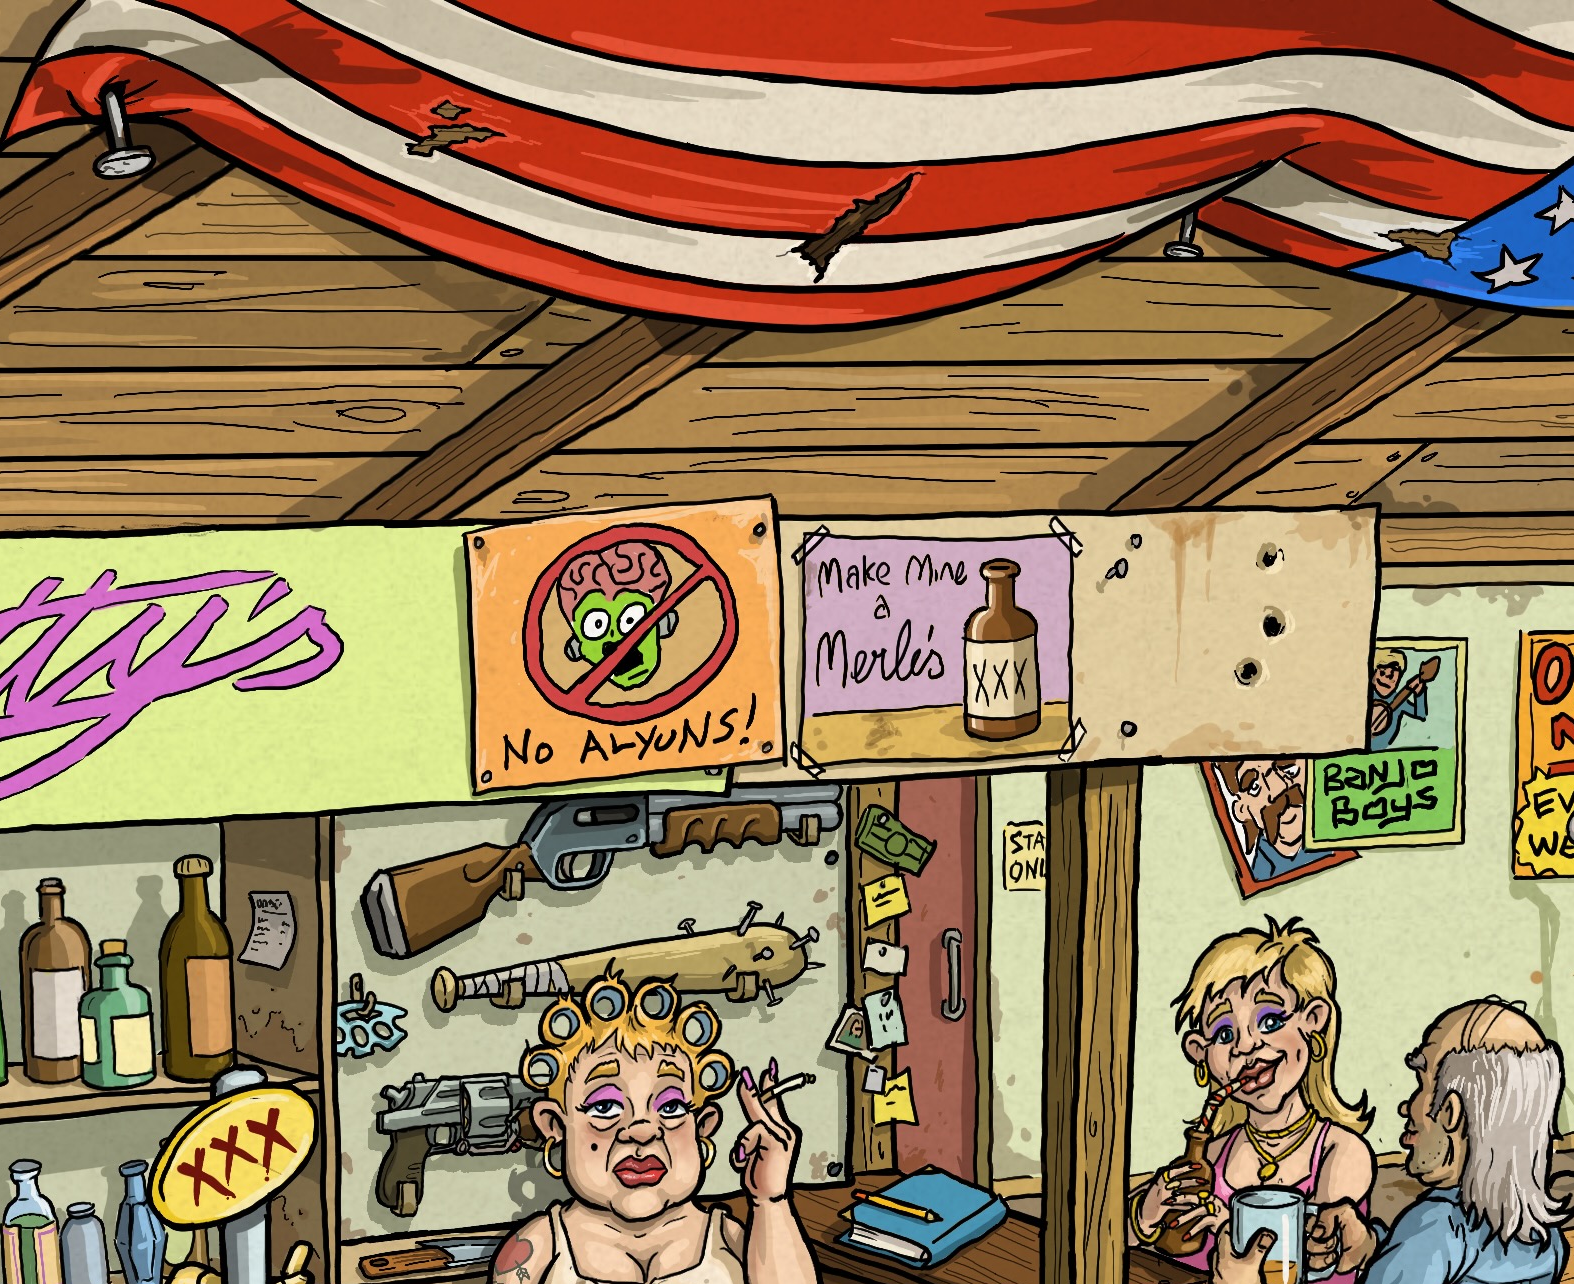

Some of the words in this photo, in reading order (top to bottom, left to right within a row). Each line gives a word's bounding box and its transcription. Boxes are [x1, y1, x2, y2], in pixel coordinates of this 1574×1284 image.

[818, 555, 891, 597] Make
[816, 619, 944, 688] Merle's
[973, 658, 1027, 707] XXX
[1010, 830, 1045, 854] STA
[1009, 857, 1046, 883] ONL
[177, 1108, 297, 1207] XXX
